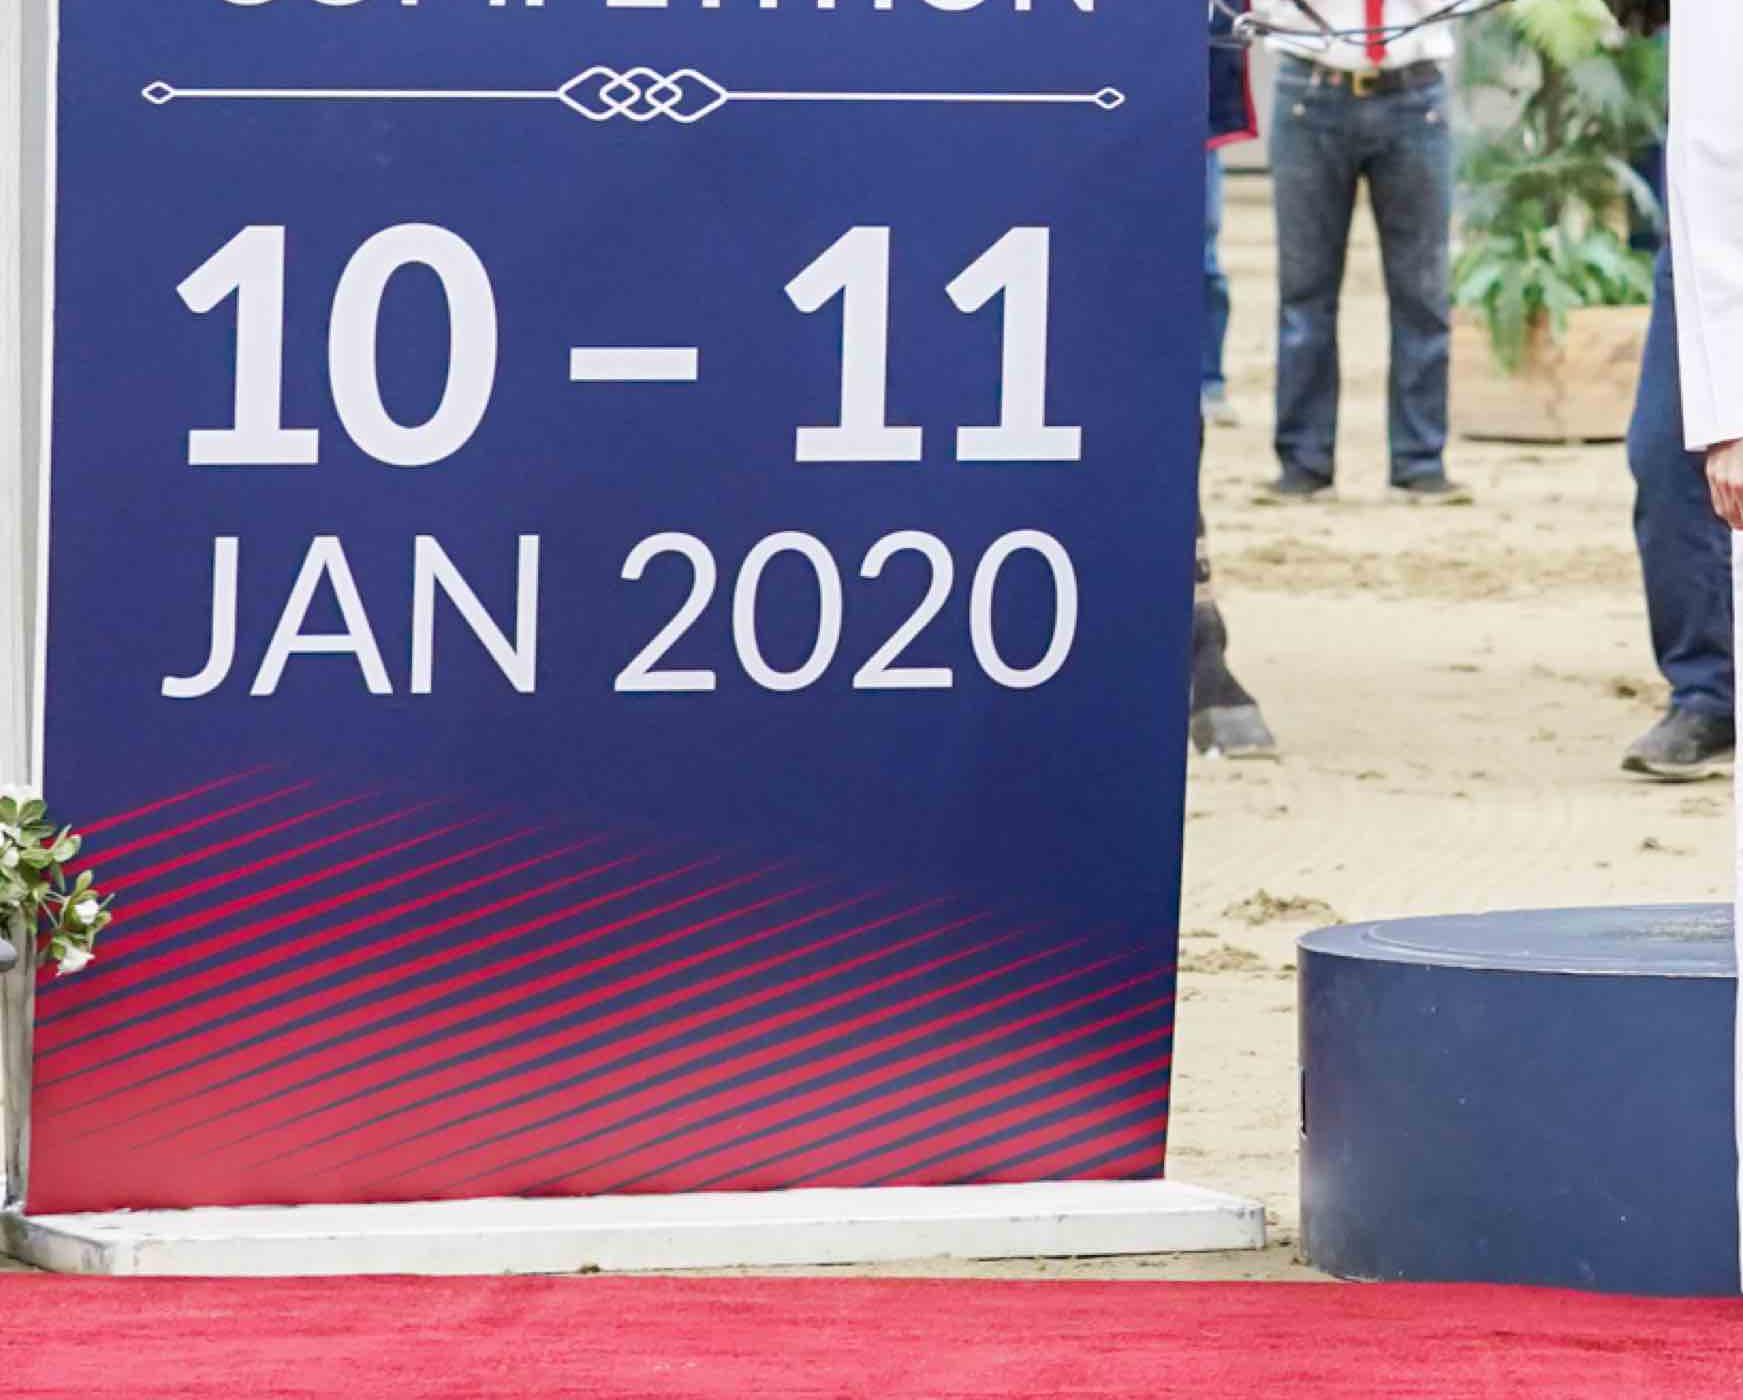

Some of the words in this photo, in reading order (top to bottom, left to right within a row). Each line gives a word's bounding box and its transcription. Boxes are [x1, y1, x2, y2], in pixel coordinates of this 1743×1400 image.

[175, 221, 498, 466] 10
[783, 224, 1082, 463] 11
[160, 533, 541, 698] JAN
[612, 528, 1079, 693] 2020
